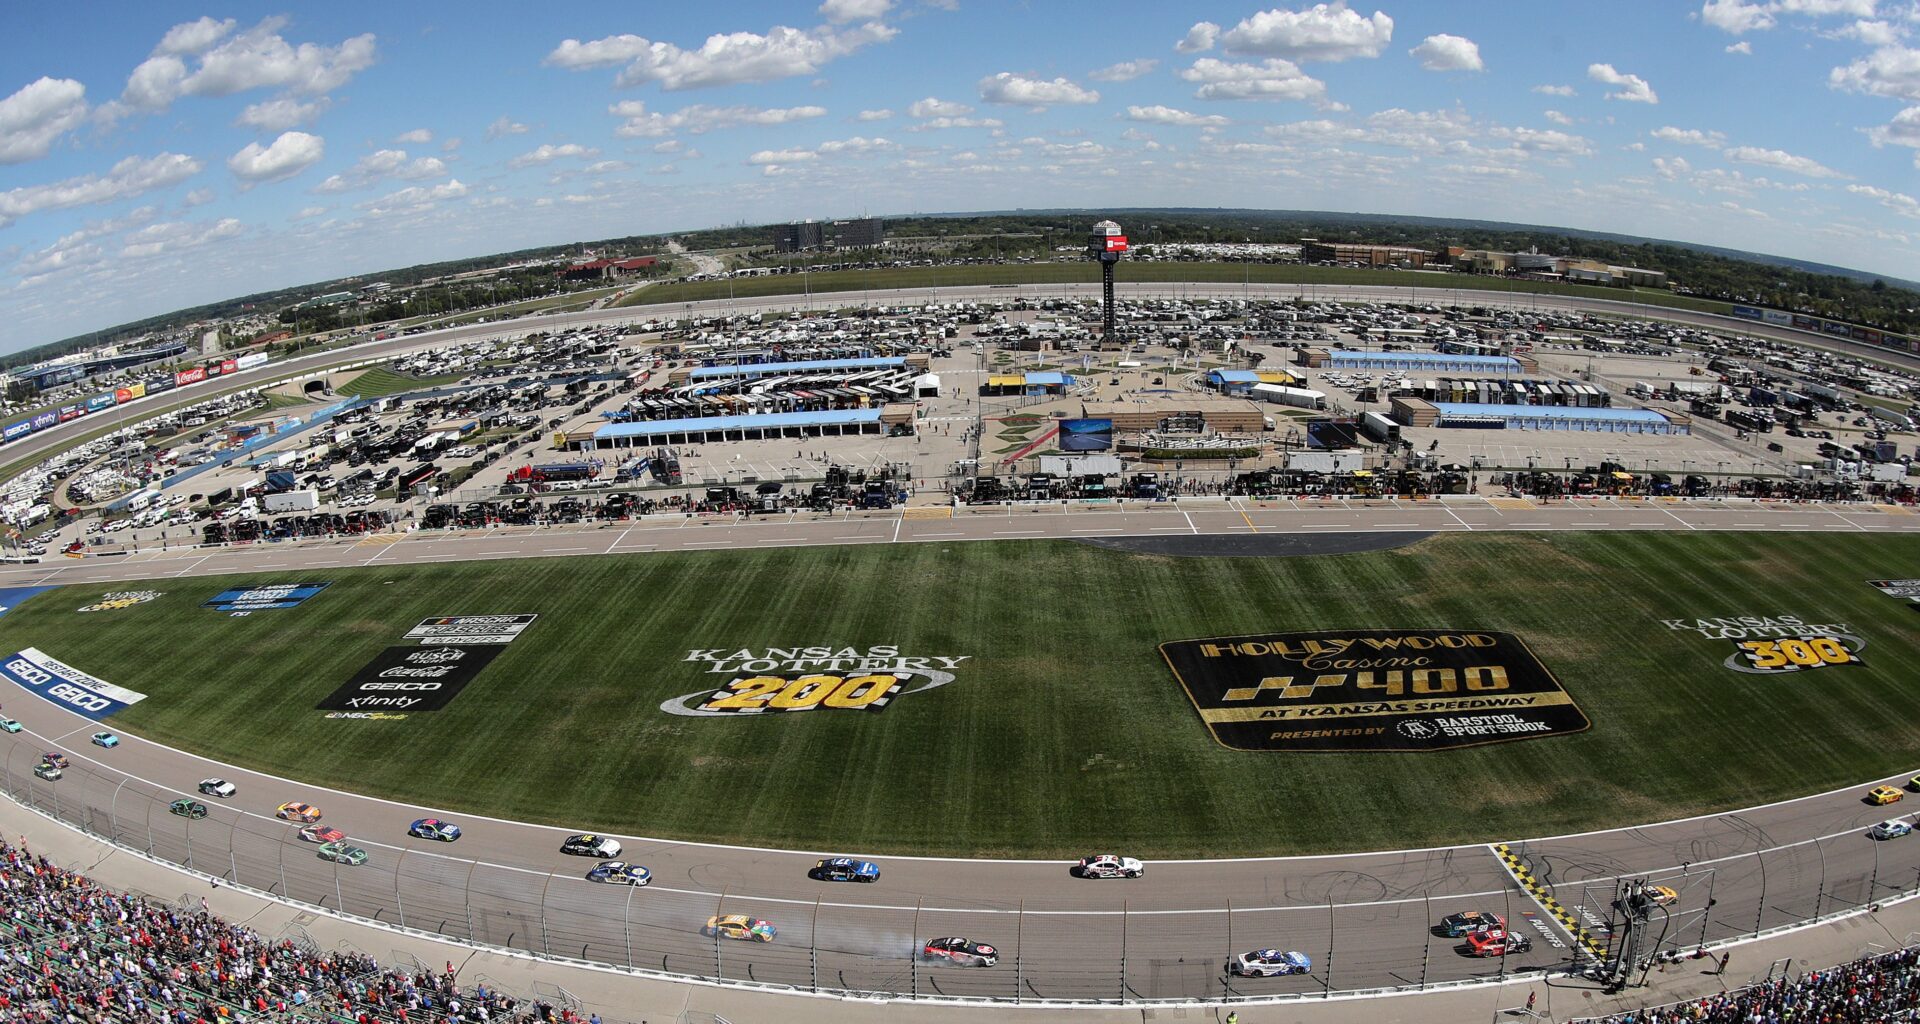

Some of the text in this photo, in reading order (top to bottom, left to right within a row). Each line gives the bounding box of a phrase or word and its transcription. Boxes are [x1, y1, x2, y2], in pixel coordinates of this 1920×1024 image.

[6, 422, 31, 437] GEICO
[456, 616, 520, 625] NASCAR
[1660, 615, 1804, 631] KANSAS
[1698, 623, 1853, 640] LOTTERY
[681, 645, 899, 661] KANSAS
[1200, 634, 1497, 657] HOLLYWOOD
[1743, 638, 1851, 667] 300
[404, 651, 467, 661] BUSCH
[1282, 648, 1433, 670] Casino
[5, 658, 52, 685] GEICO
[705, 656, 972, 674] LOTTERY
[359, 682, 443, 690] GEICO
[1356, 665, 1510, 695] 400
[47, 683, 111, 712] GEICO
[705, 675, 898, 708] 200
[345, 695, 422, 708] xfinity
[1259, 697, 1537, 719] AT KANSAS SPEEDWAY
[1434, 714, 1525, 728] BARSTOOL
[1444, 722, 1552, 737] SPORTSBOOK
[1270, 727, 1385, 740] PRESENTED BY
[1528, 919, 1566, 948] PLAYOFFS
